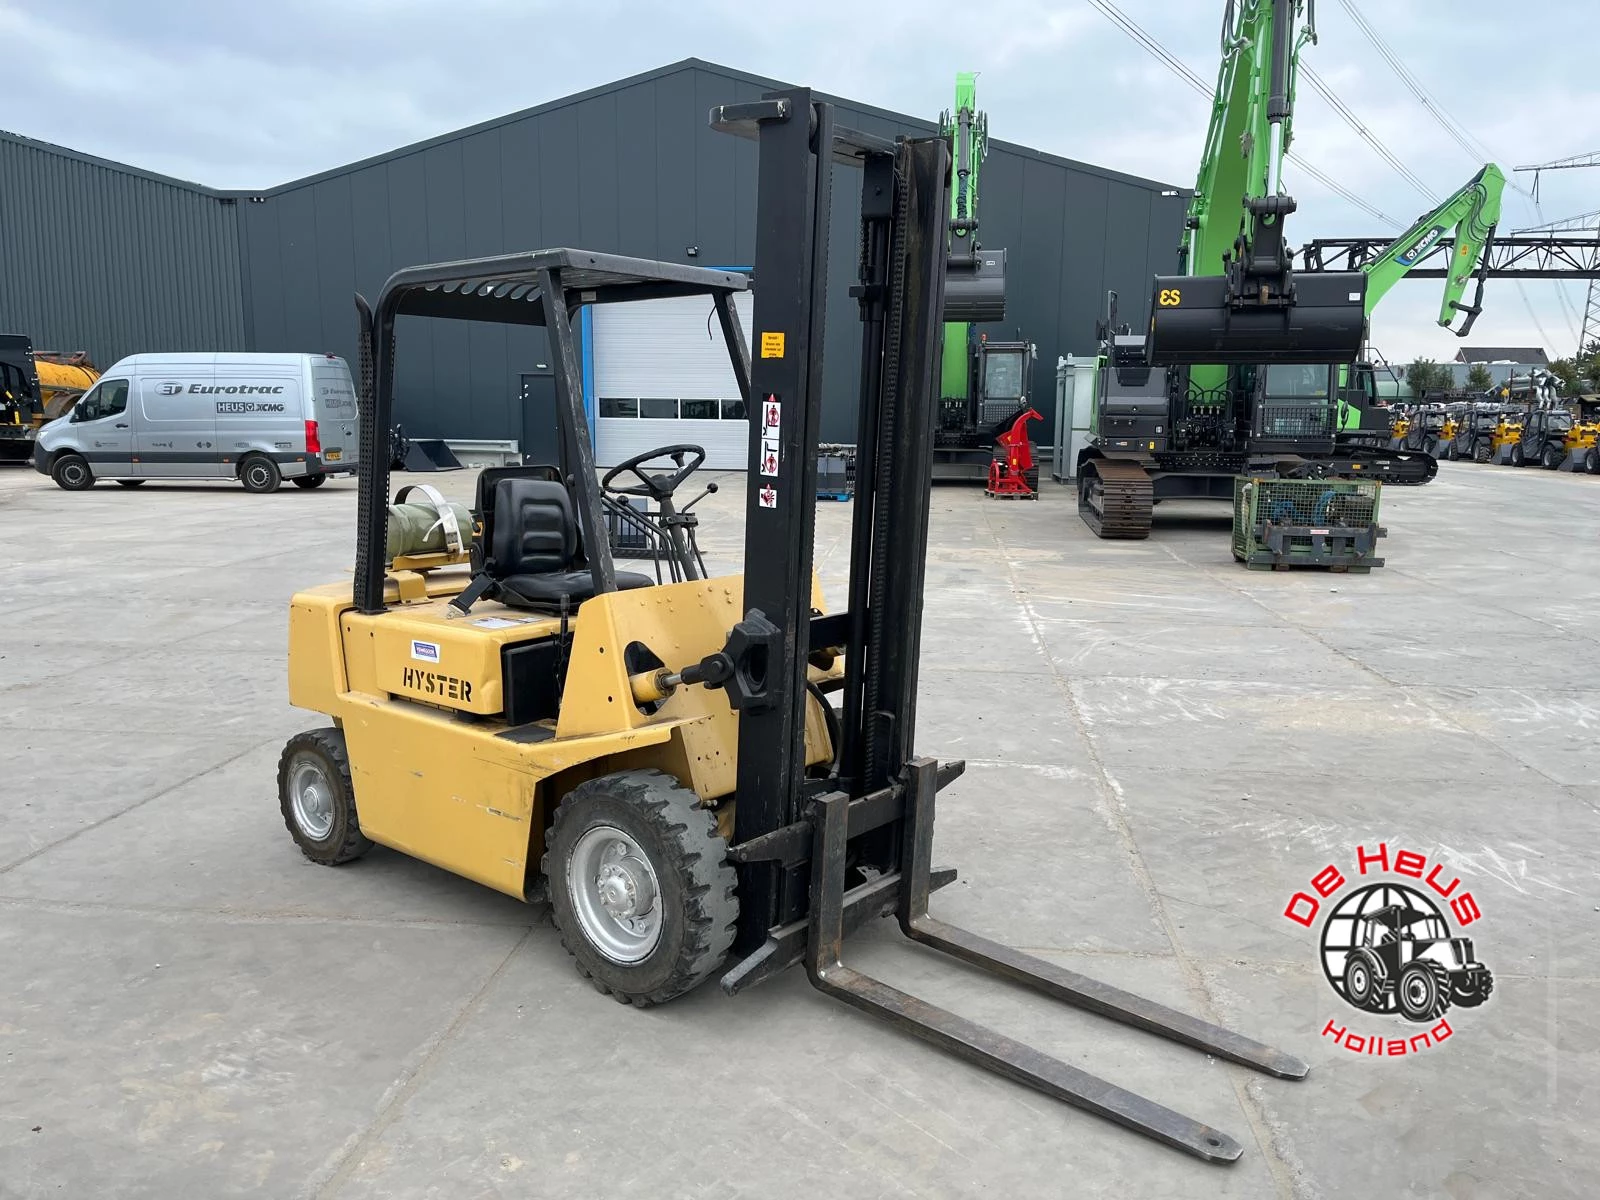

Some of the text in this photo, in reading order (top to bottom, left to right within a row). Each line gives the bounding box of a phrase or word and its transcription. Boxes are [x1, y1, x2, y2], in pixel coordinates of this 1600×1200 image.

[1414, 229, 1438, 253] XCMG
[188, 383, 284, 394] Eurotrac
[217, 403, 284, 412] HEUS XCMG
[403, 667, 472, 702] HYSTER
